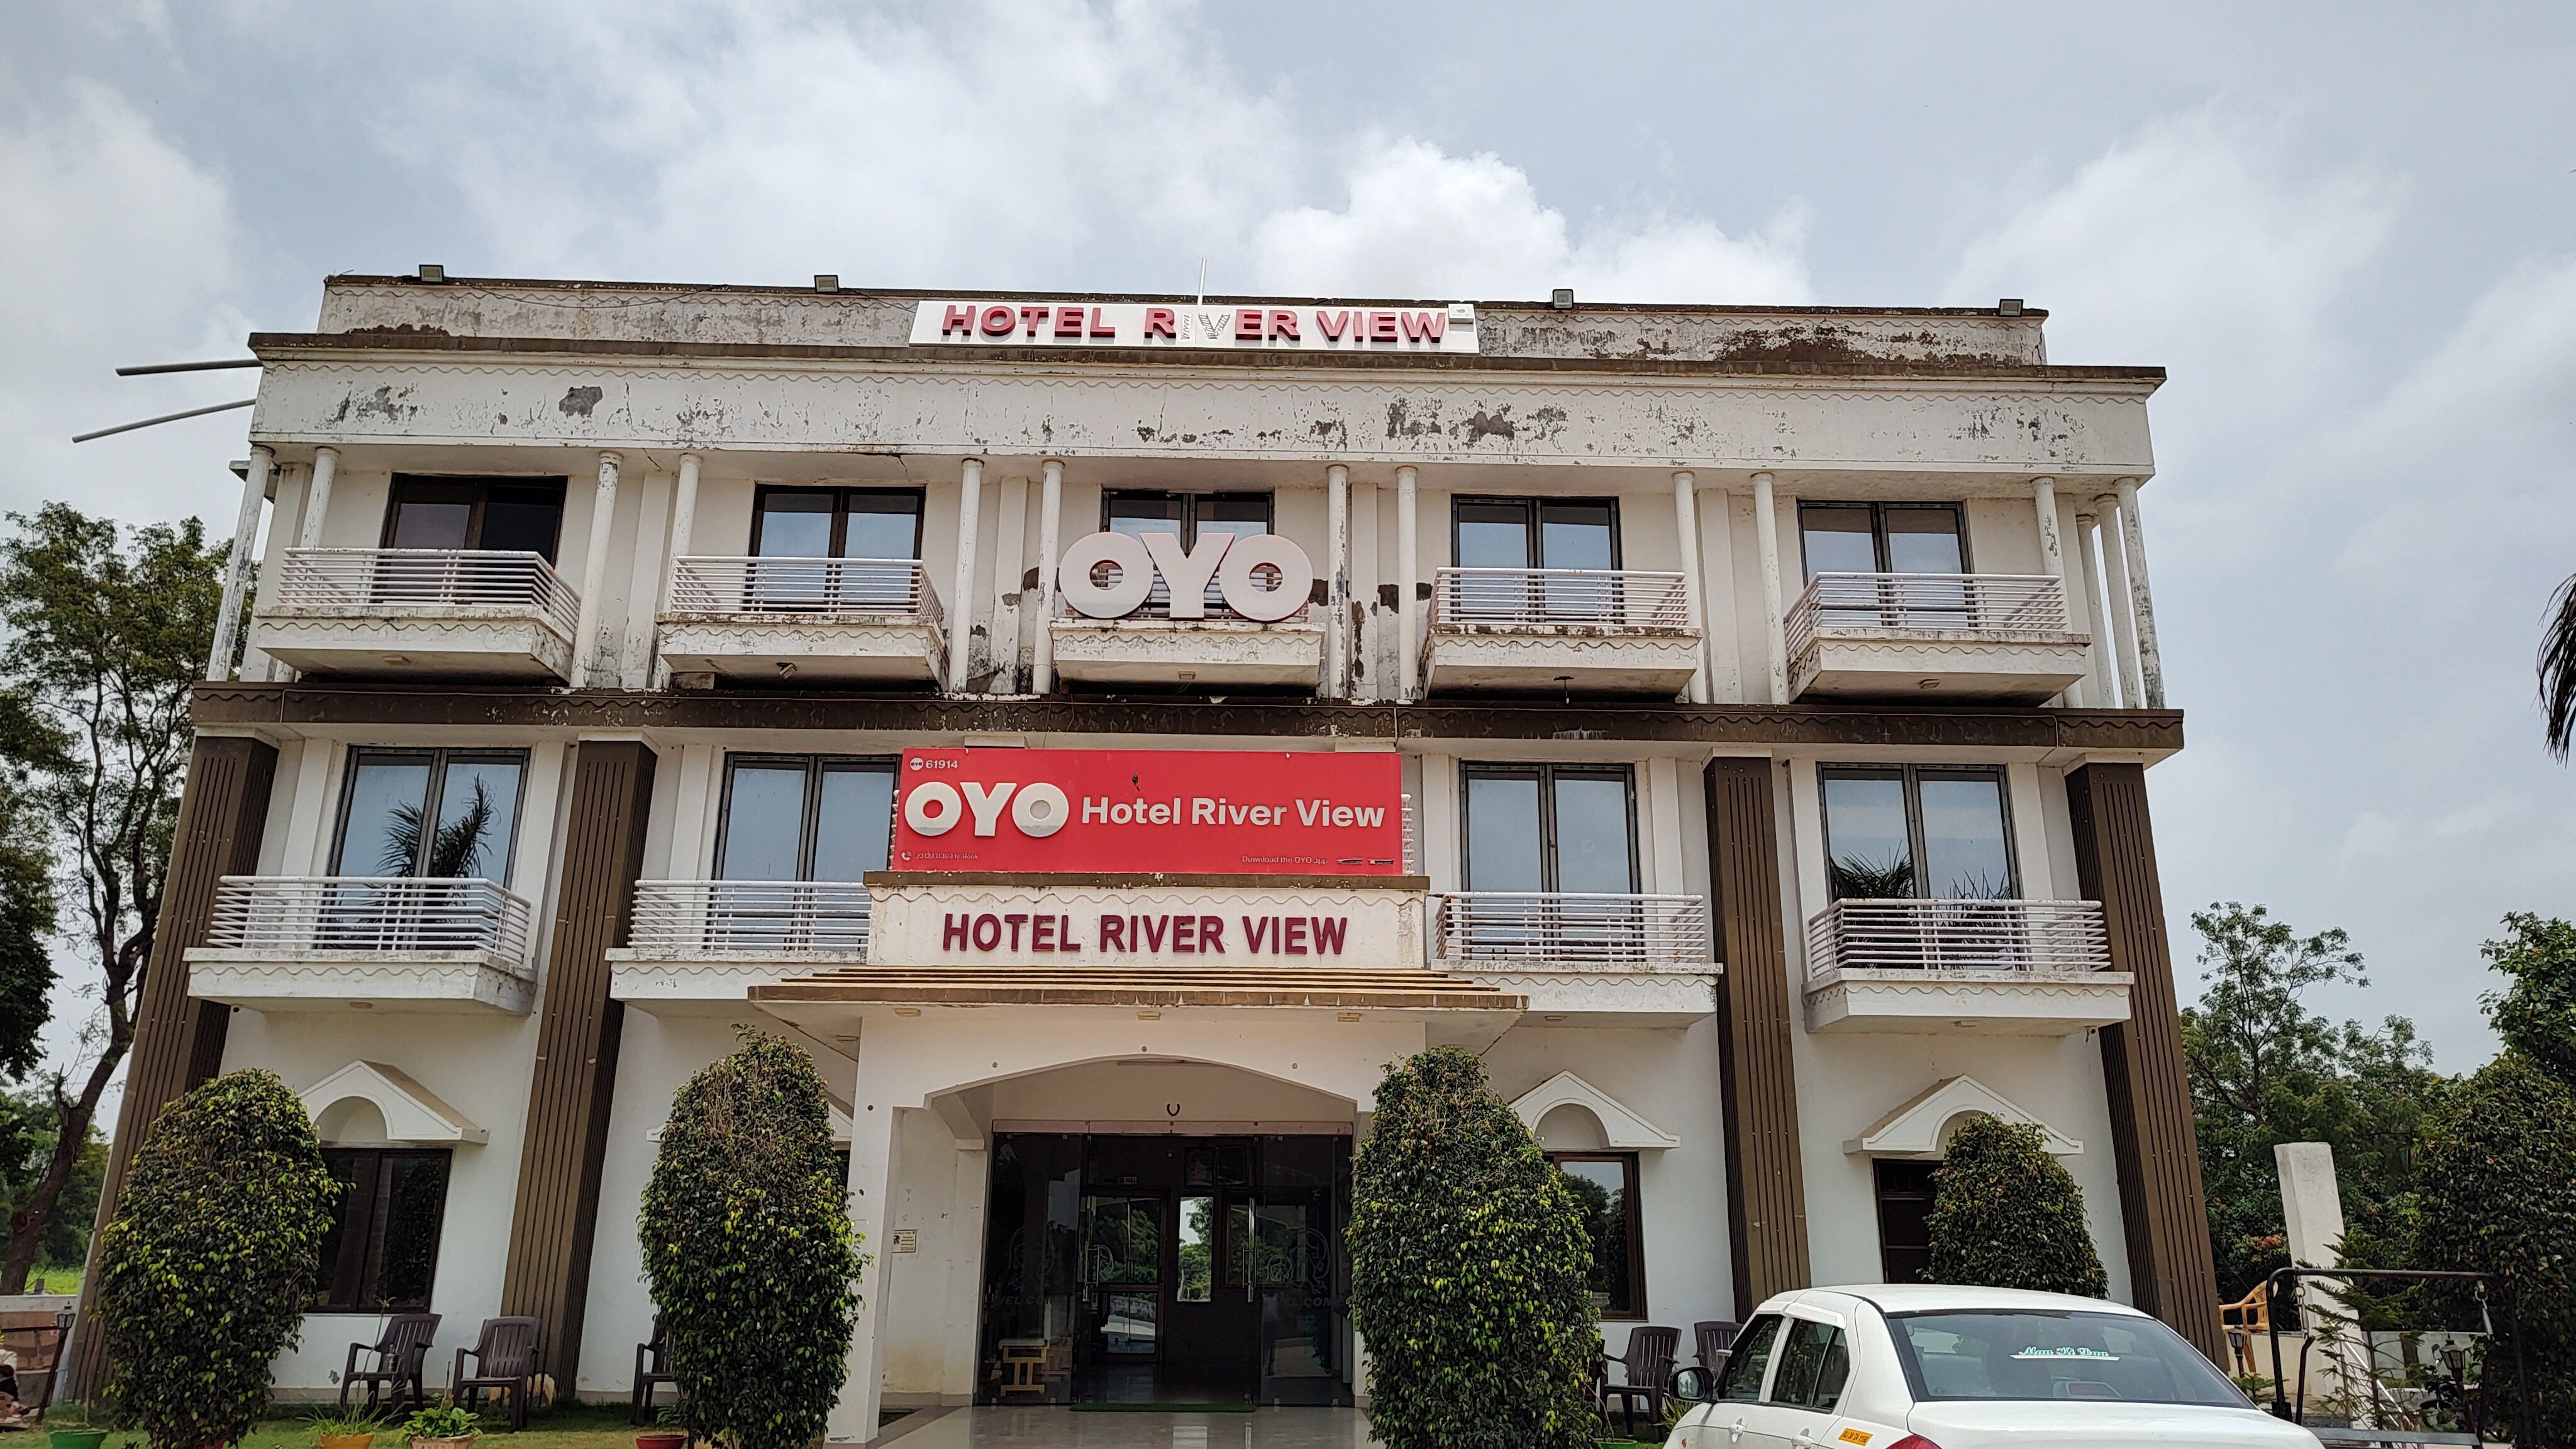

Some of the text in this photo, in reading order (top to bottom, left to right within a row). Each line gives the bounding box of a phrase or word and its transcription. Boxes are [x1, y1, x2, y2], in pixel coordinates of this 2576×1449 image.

[942, 305, 1446, 343] HOTEL RIVER VIEW
[1058, 532, 1313, 623] OYO
[925, 760, 958, 769] 61914
[904, 781, 1069, 838] OYO
[1082, 796, 1385, 828] Hotel River View
[1242, 855, 1279, 863] Download
[943, 913, 1348, 954] HOTEL RIVER VIEW
[2056, 1346, 2076, 1356] Ki
